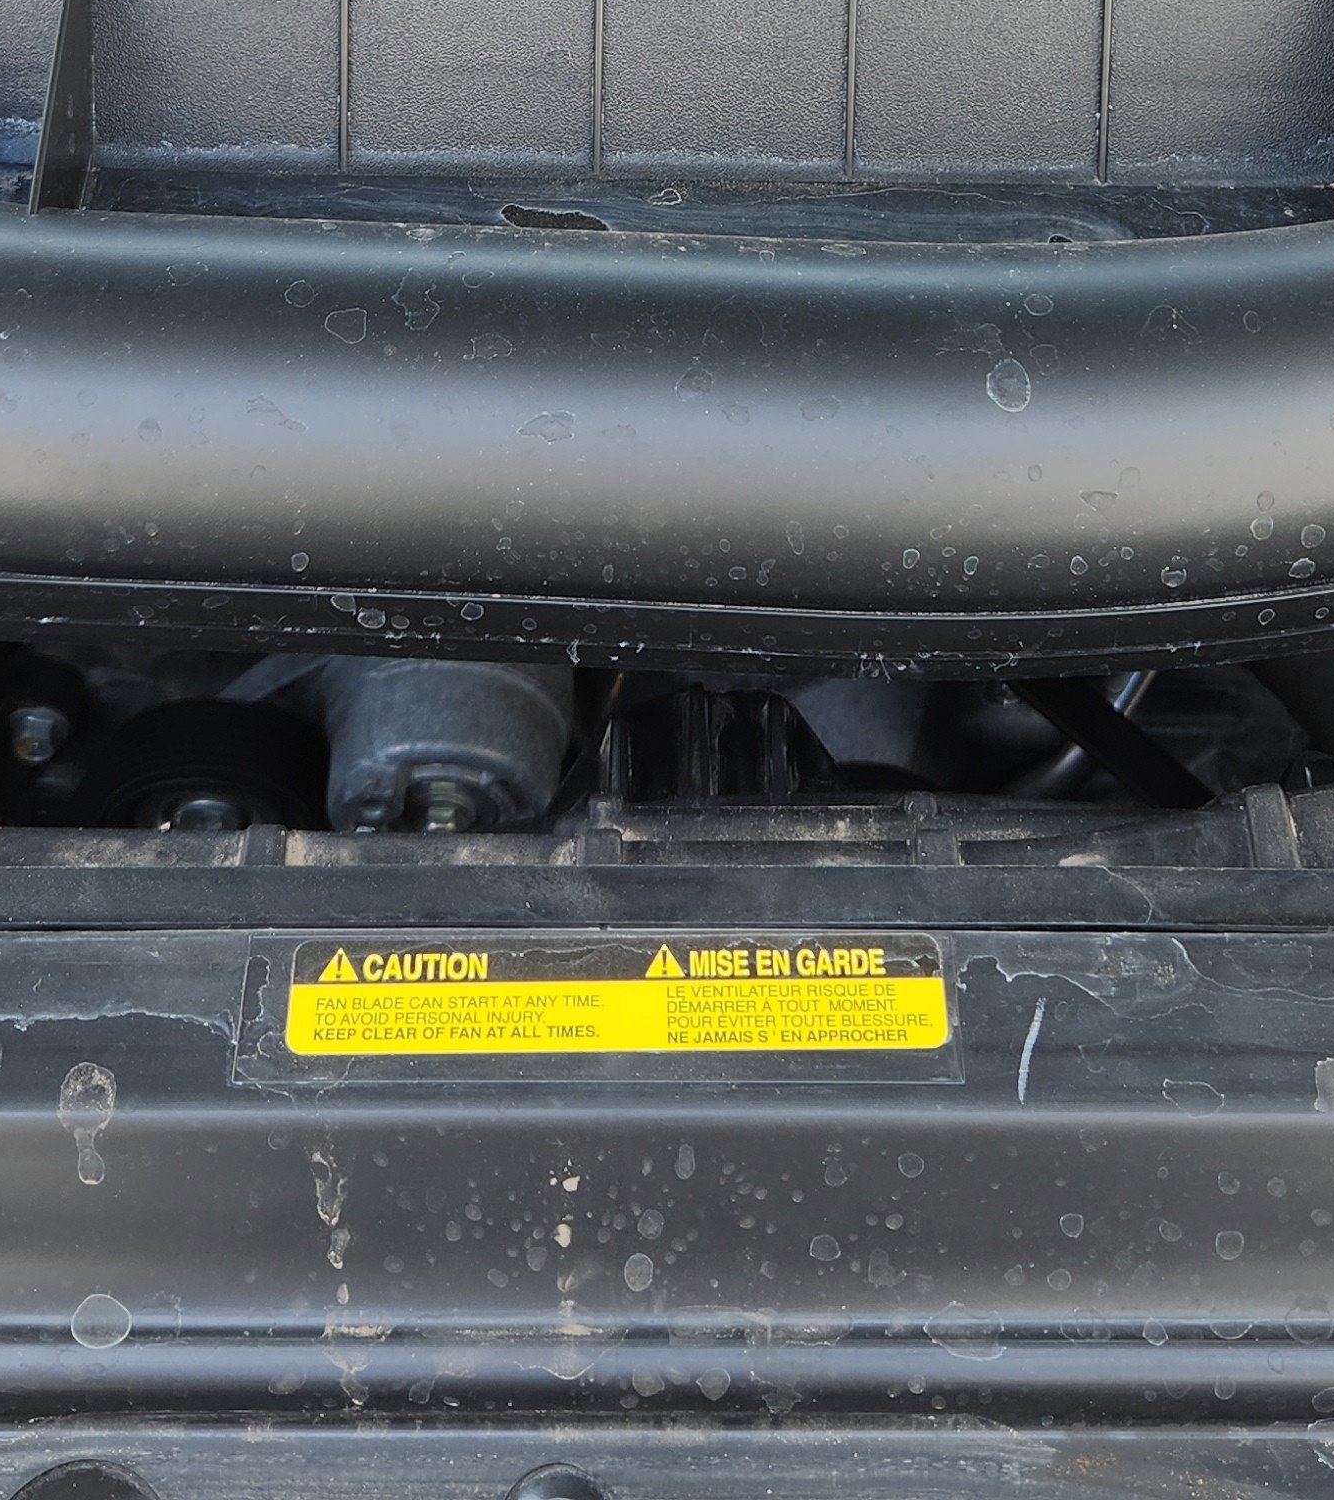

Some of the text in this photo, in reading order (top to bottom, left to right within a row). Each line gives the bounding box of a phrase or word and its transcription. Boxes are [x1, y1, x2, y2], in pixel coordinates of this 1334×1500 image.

[362, 952, 489, 982] CAUTION
[689, 948, 887, 978] MISE EN GARDE
[666, 983, 896, 998] LE VENTILATEUR RISQUE DE
[316, 994, 604, 1010] FAN BLADE CAN START AT ANY TIME.
[667, 997, 757, 1014] DÉMARRER
[777, 1000, 819, 1012] TOUT
[829, 999, 898, 1012] MOMENT.
[315, 1011, 546, 1026] TO AVOID PERSONAL INJURY,
[667, 1015, 712, 1028] POUR
[782, 1014, 836, 1027] TOUTE
[842, 1013, 934, 1027] BLESSURE,
[313, 1025, 600, 1041] KEEP CLEAR OF FAN AT ALL TIMES.
[668, 1031, 689, 1044] NE
[694, 1031, 753, 1043] JAMAIS
[807, 1029, 908, 1042] APPROCHER
